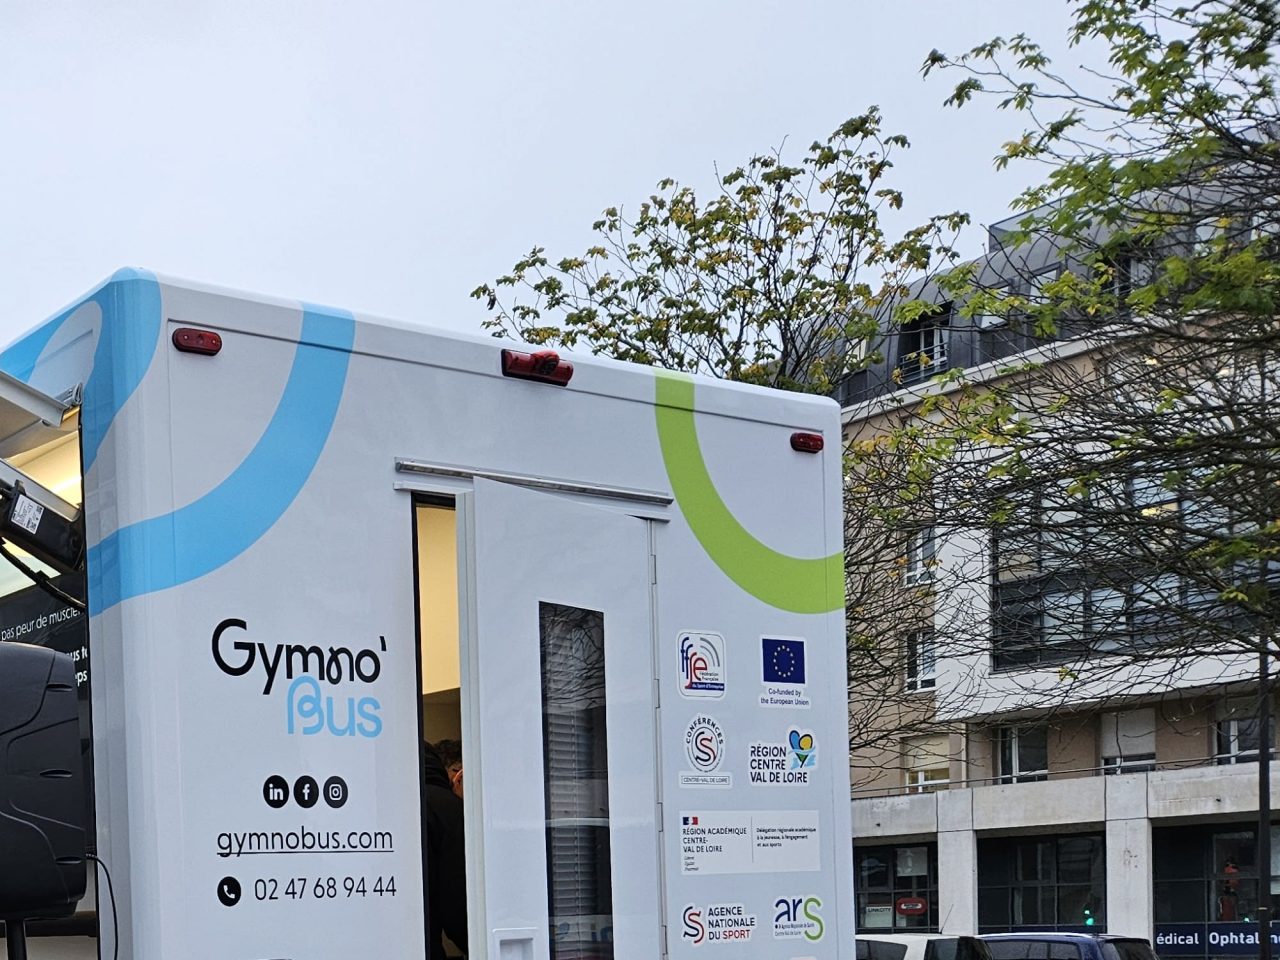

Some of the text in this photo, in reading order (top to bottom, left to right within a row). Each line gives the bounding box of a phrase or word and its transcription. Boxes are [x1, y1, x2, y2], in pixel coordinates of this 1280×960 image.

[1, 627, 14, 642] pas
[16, 620, 35, 640] peur
[36, 614, 48, 629] de
[49, 607, 81, 625] muscle
[75, 670, 87, 687] ps
[287, 675, 383, 738] Bus
[770, 697, 793, 706] European
[750, 743, 786, 757] RÉGION
[750, 758, 786, 770] CENTRE
[750, 771, 807, 783] VAL DE LOIRE
[683, 825, 747, 836] RÉGION ACADÉMIQUE
[217, 826, 393, 857] gymnobus.com
[254, 875, 397, 901] 02 47 68 94 44
[708, 906, 742, 916] AGENCE
[708, 917, 755, 928] NATIONALE
[709, 929, 750, 940] DU SPORT
[1156, 932, 1199, 945] édical
